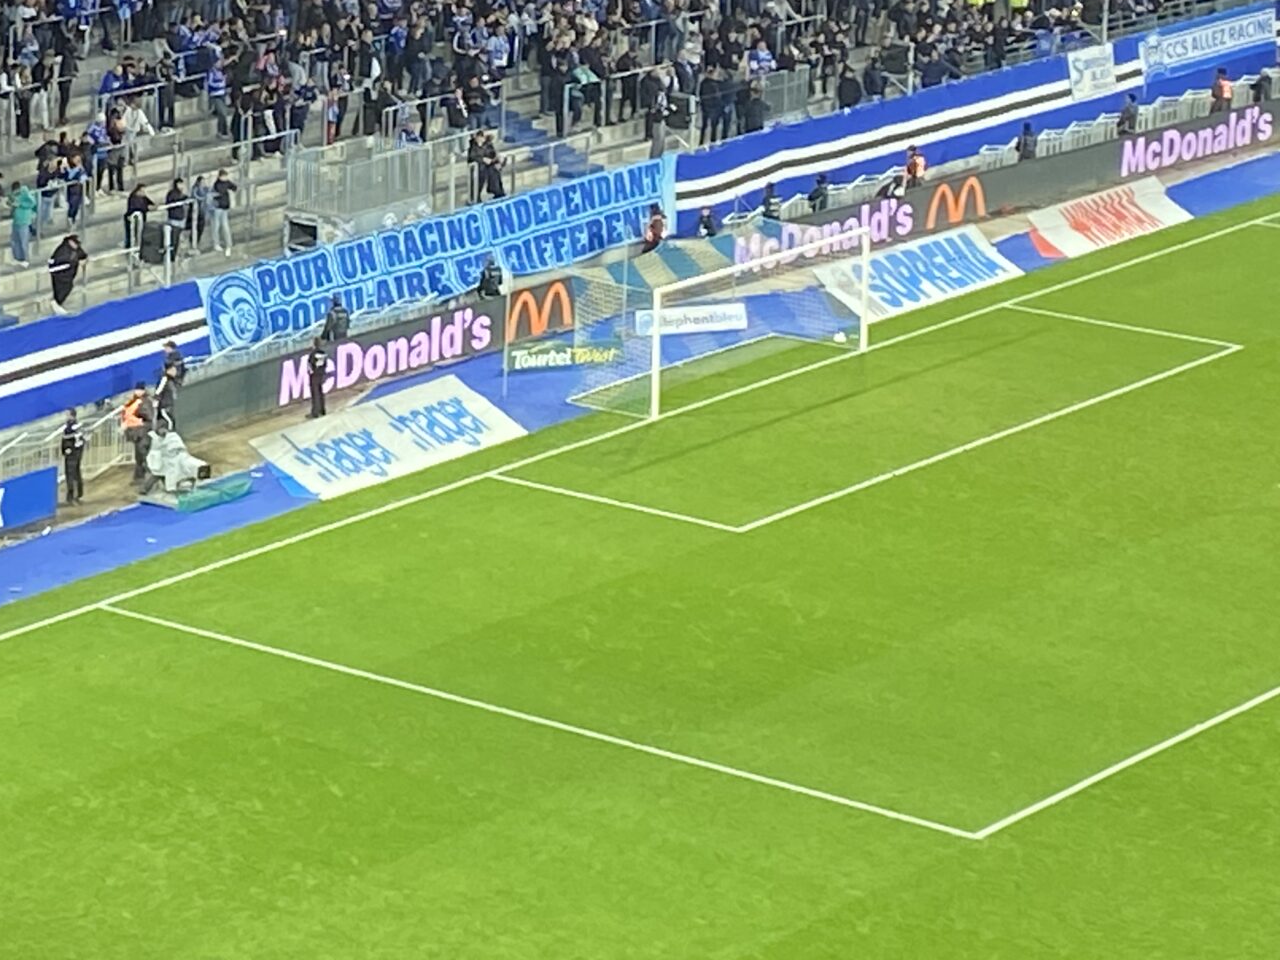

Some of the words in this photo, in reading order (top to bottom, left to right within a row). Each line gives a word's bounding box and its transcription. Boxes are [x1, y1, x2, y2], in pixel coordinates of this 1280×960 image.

[1166, 37, 1189, 59] CCS
[1192, 28, 1227, 53] ALLEZ
[1229, 16, 1273, 41] RACING
[1121, 106, 1273, 178] McDonald's
[257, 252, 334, 303] POUR
[337, 239, 378, 282] UN
[384, 211, 483, 268] RACING
[489, 161, 662, 241] INDEPENDANT
[734, 198, 914, 277] McDonald's
[279, 308, 492, 407] McDonald's
[512, 347, 572, 370] Tourtel
